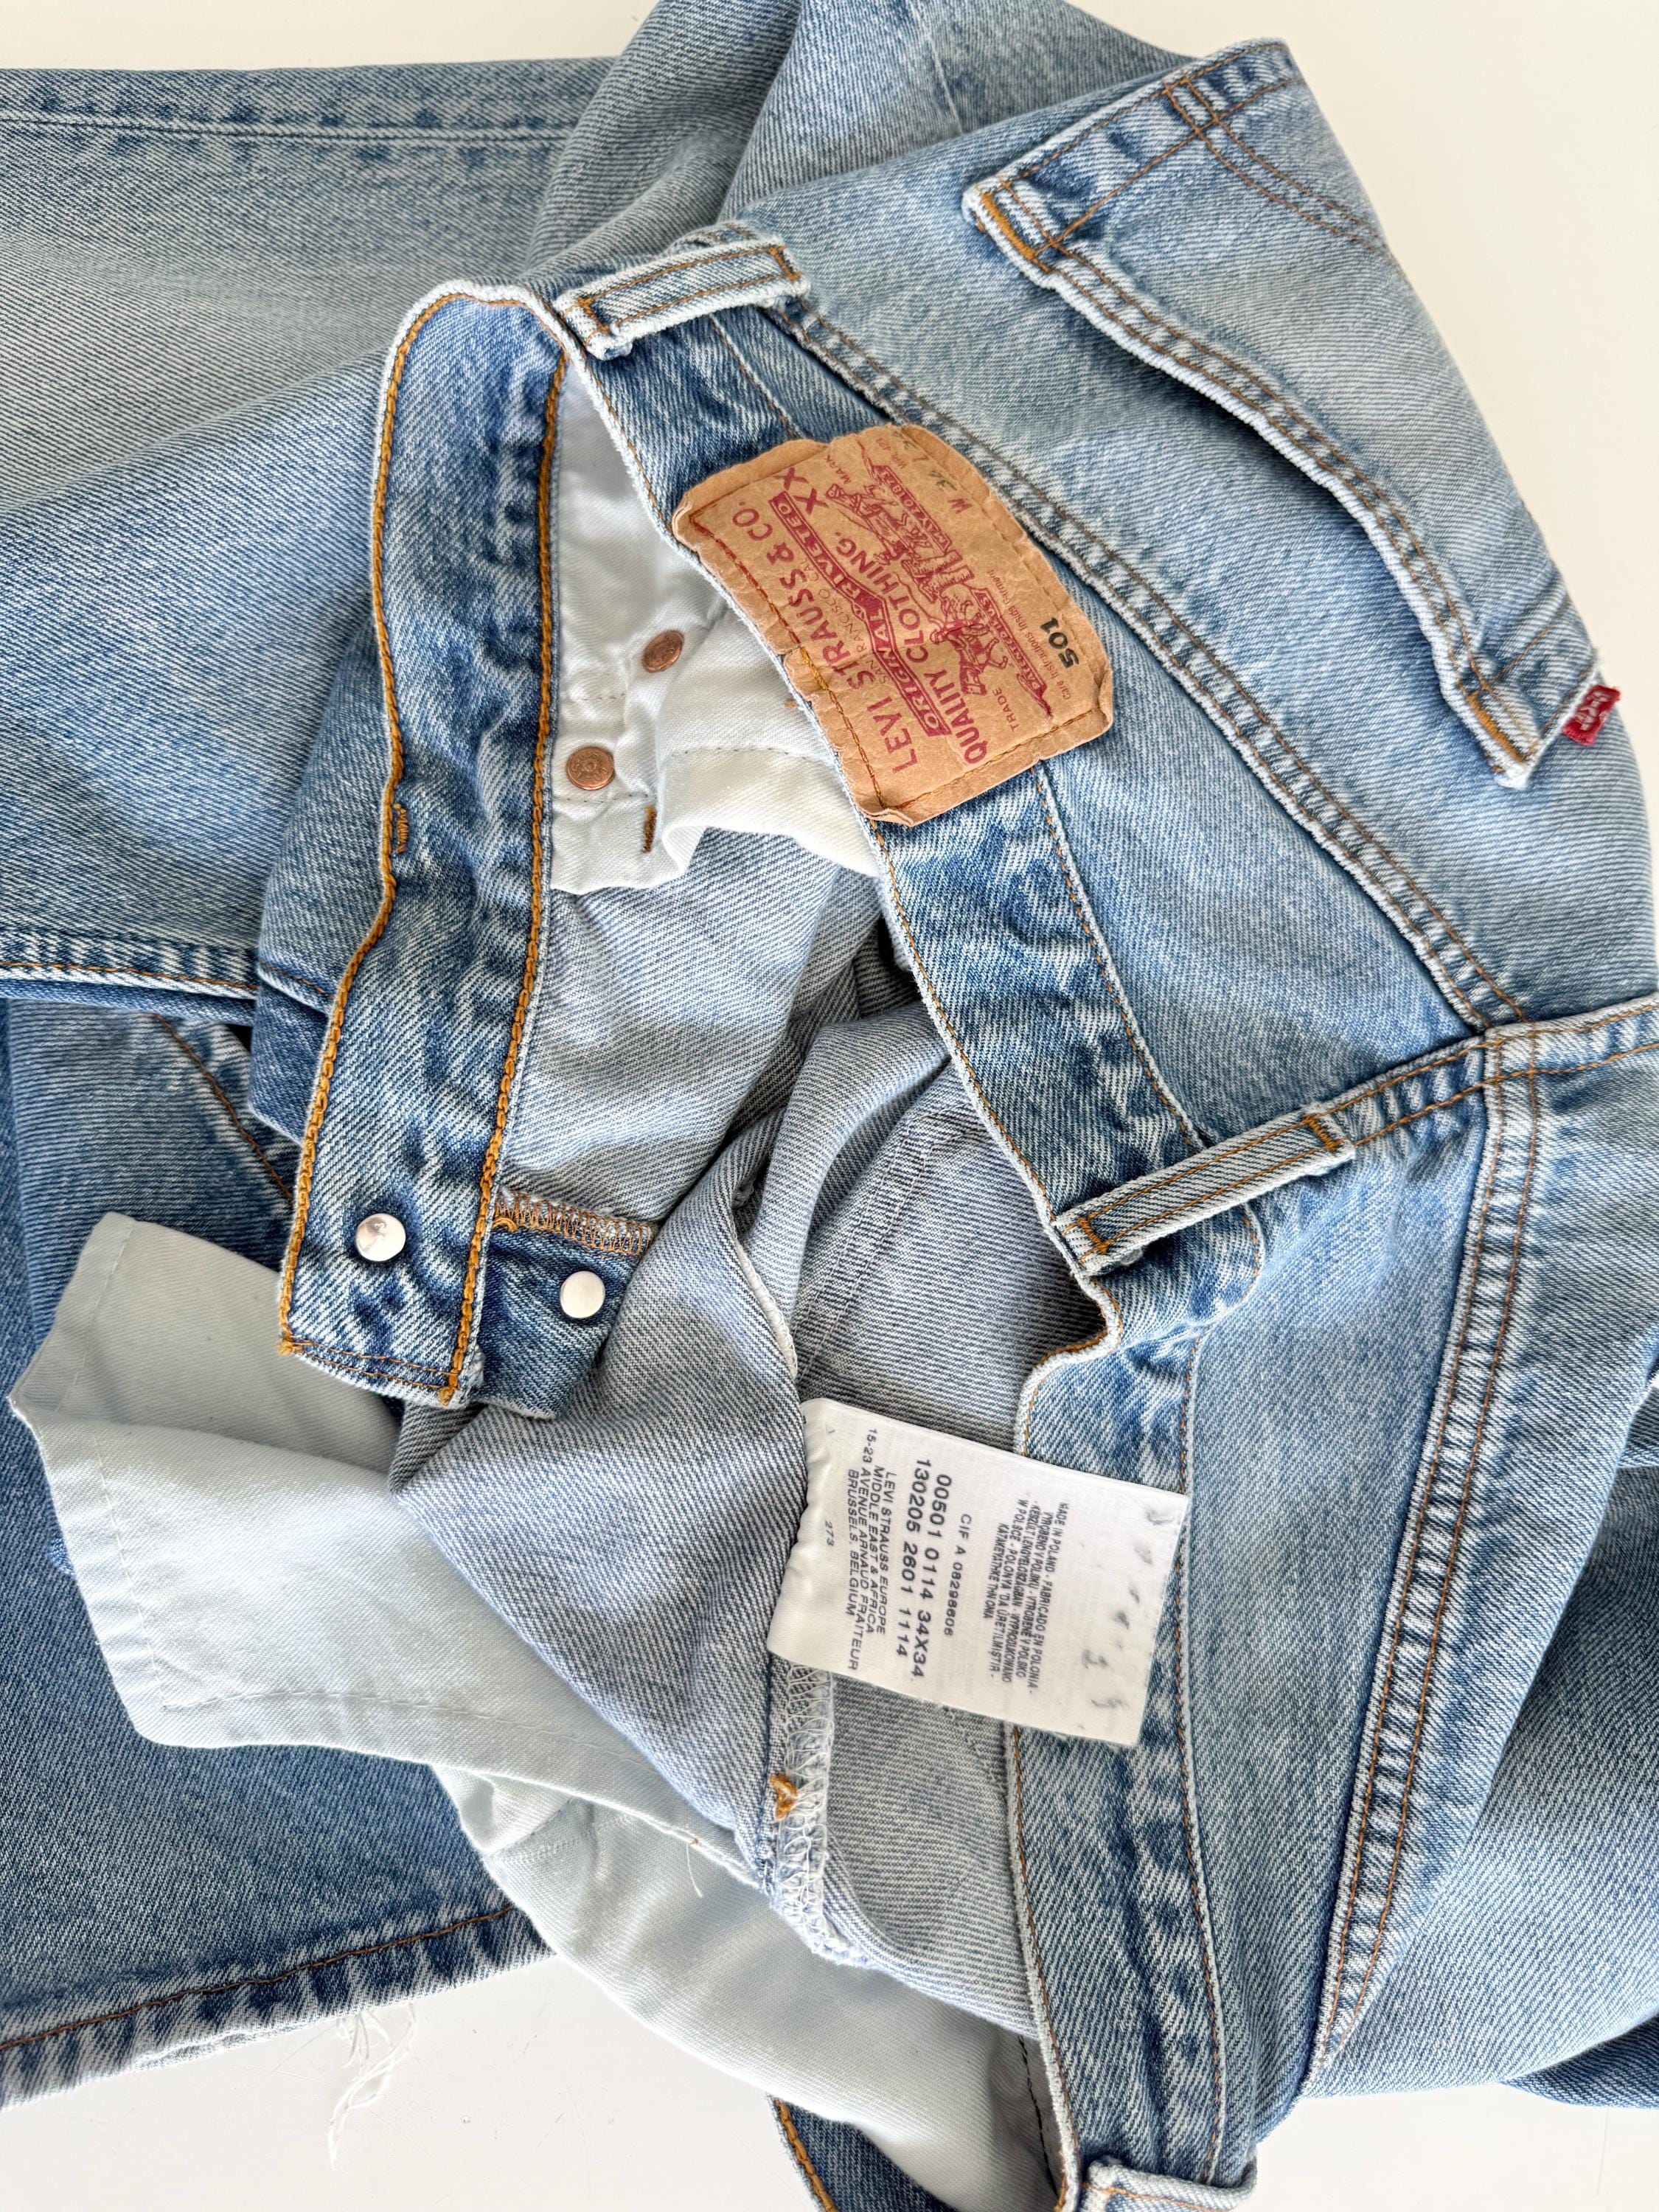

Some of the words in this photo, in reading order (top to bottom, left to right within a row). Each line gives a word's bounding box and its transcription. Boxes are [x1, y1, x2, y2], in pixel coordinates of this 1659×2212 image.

[773, 467, 830, 515] XX
[824, 454, 852, 484] MARK
[732, 501, 773, 541] CO.
[919, 516, 947, 546] MAY
[766, 541, 795, 566] &
[777, 502, 860, 599] RIVETED
[835, 531, 929, 663] CLOTHING.
[1007, 604, 1028, 630] Inside
[779, 568, 876, 689] STRAUSS
[1040, 616, 1079, 669] 501
[868, 660, 890, 685] SAN
[869, 608, 939, 729] ORIGINAL
[1023, 630, 1059, 680] Instructions
[988, 686, 1023, 731] TRADE
[1054, 680, 1072, 700] Care
[866, 697, 918, 774] LEVI
[924, 669, 988, 765] QUALITY
[862, 1429, 878, 1464] 15-23
[855, 1467, 872, 1526] AVENUE
[869, 1465, 886, 1522] MIDDLE
[883, 1471, 897, 1503] LEVI
[905, 1459, 932, 1533] 130205
[927, 1473, 953, 1538] 00501
[1018, 1499, 1029, 1508] W
[824, 1520, 835, 1547] 273
[958, 1513, 973, 1540] CIF
[1009, 1508, 1027, 1542] POLSCE
[1052, 1527, 1064, 1537] IN
[1054, 1502, 1069, 1526] MADE
[857, 1529, 869, 1590] ARNAUD
[866, 1524, 878, 1562] EAST
[876, 1506, 892, 1573] STRAUSS
[954, 1545, 967, 1555] A
[1045, 1538, 1062, 1573] POLAND
[845, 1550, 860, 1616] BELGIUM
[870, 1565, 879, 1575] &
[900, 1540, 919, 1594] 2601
[919, 1547, 940, 1600] 0114
[1000, 1548, 1018, 1590] POLONYA
[865, 1579, 879, 1633] AFRICA
[874, 1575, 888, 1635] EUROPE
[1035, 1579, 1053, 1632] FABRICADO
[848, 1594, 869, 1671] FRAITEUR
[896, 1607, 912, 1657] 1114
[911, 1610, 932, 1677] 34X34
[1032, 1632, 1045, 1646] EN
[1027, 1648, 1043, 1688] POLONIA
